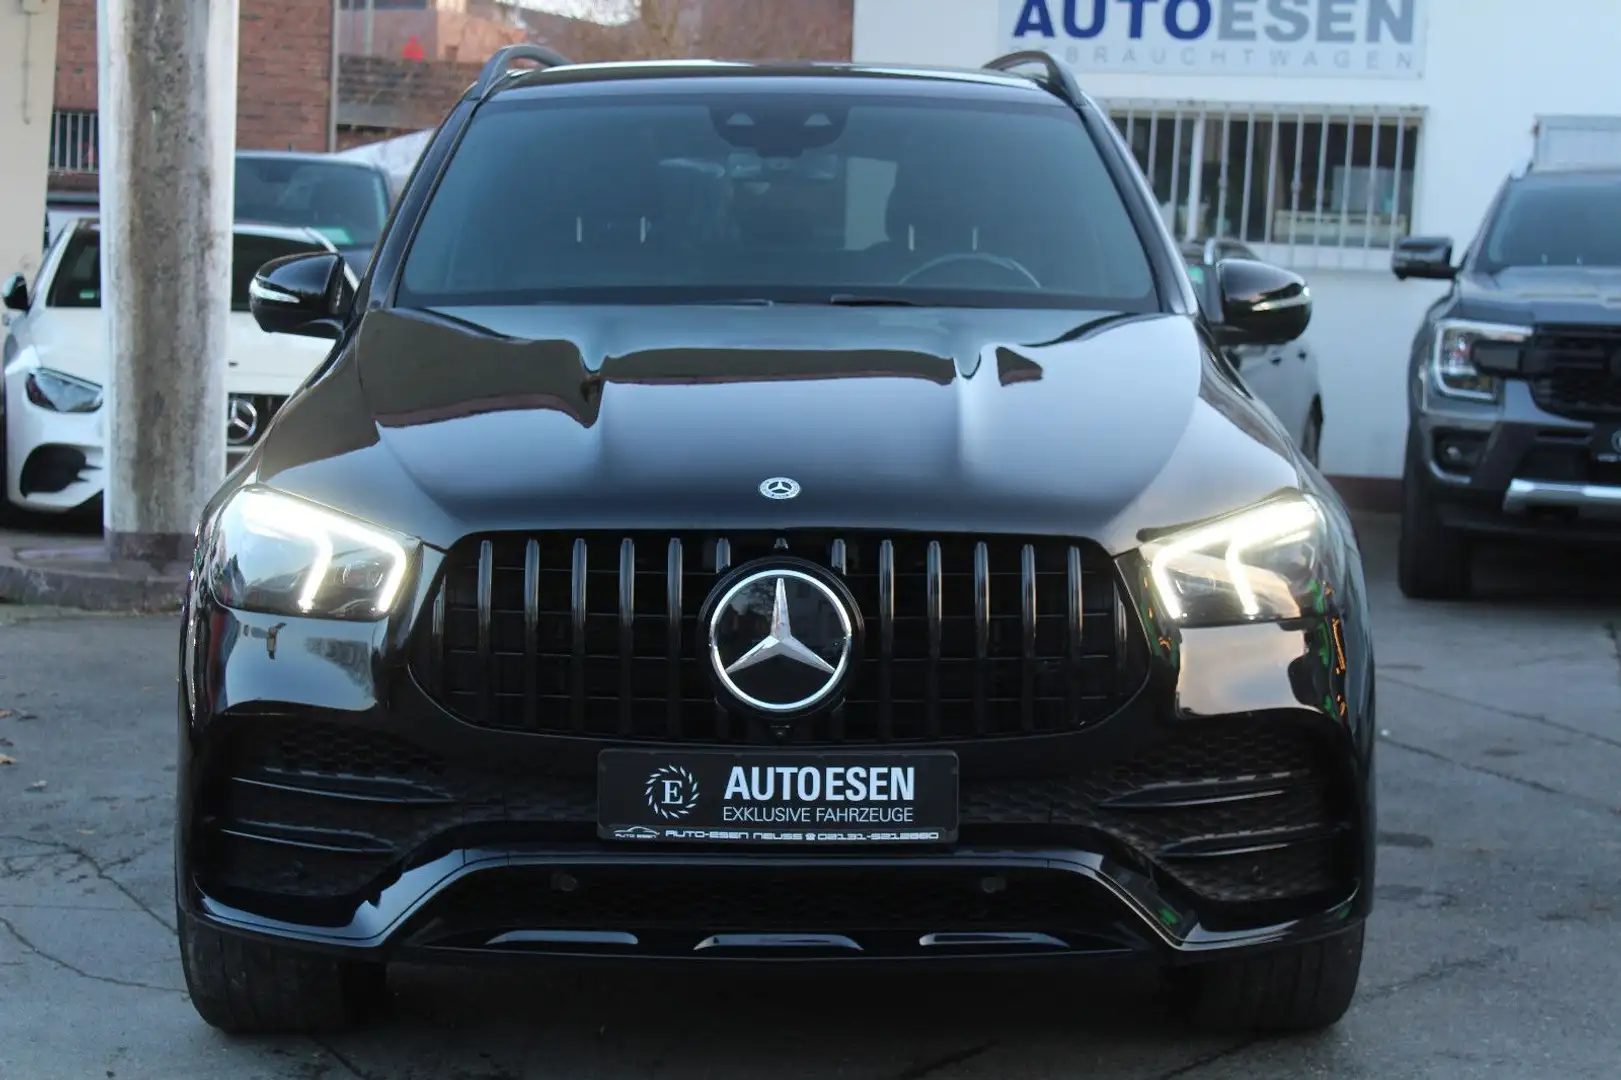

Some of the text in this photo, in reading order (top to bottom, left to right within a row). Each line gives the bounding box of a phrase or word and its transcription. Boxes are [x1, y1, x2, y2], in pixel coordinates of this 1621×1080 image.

[1010, 46, 1413, 69] BRAUCHTWAGEN
[661, 780, 683, 804] E
[723, 806, 914, 822] EXKLUSIVE FAHRZEUGE
